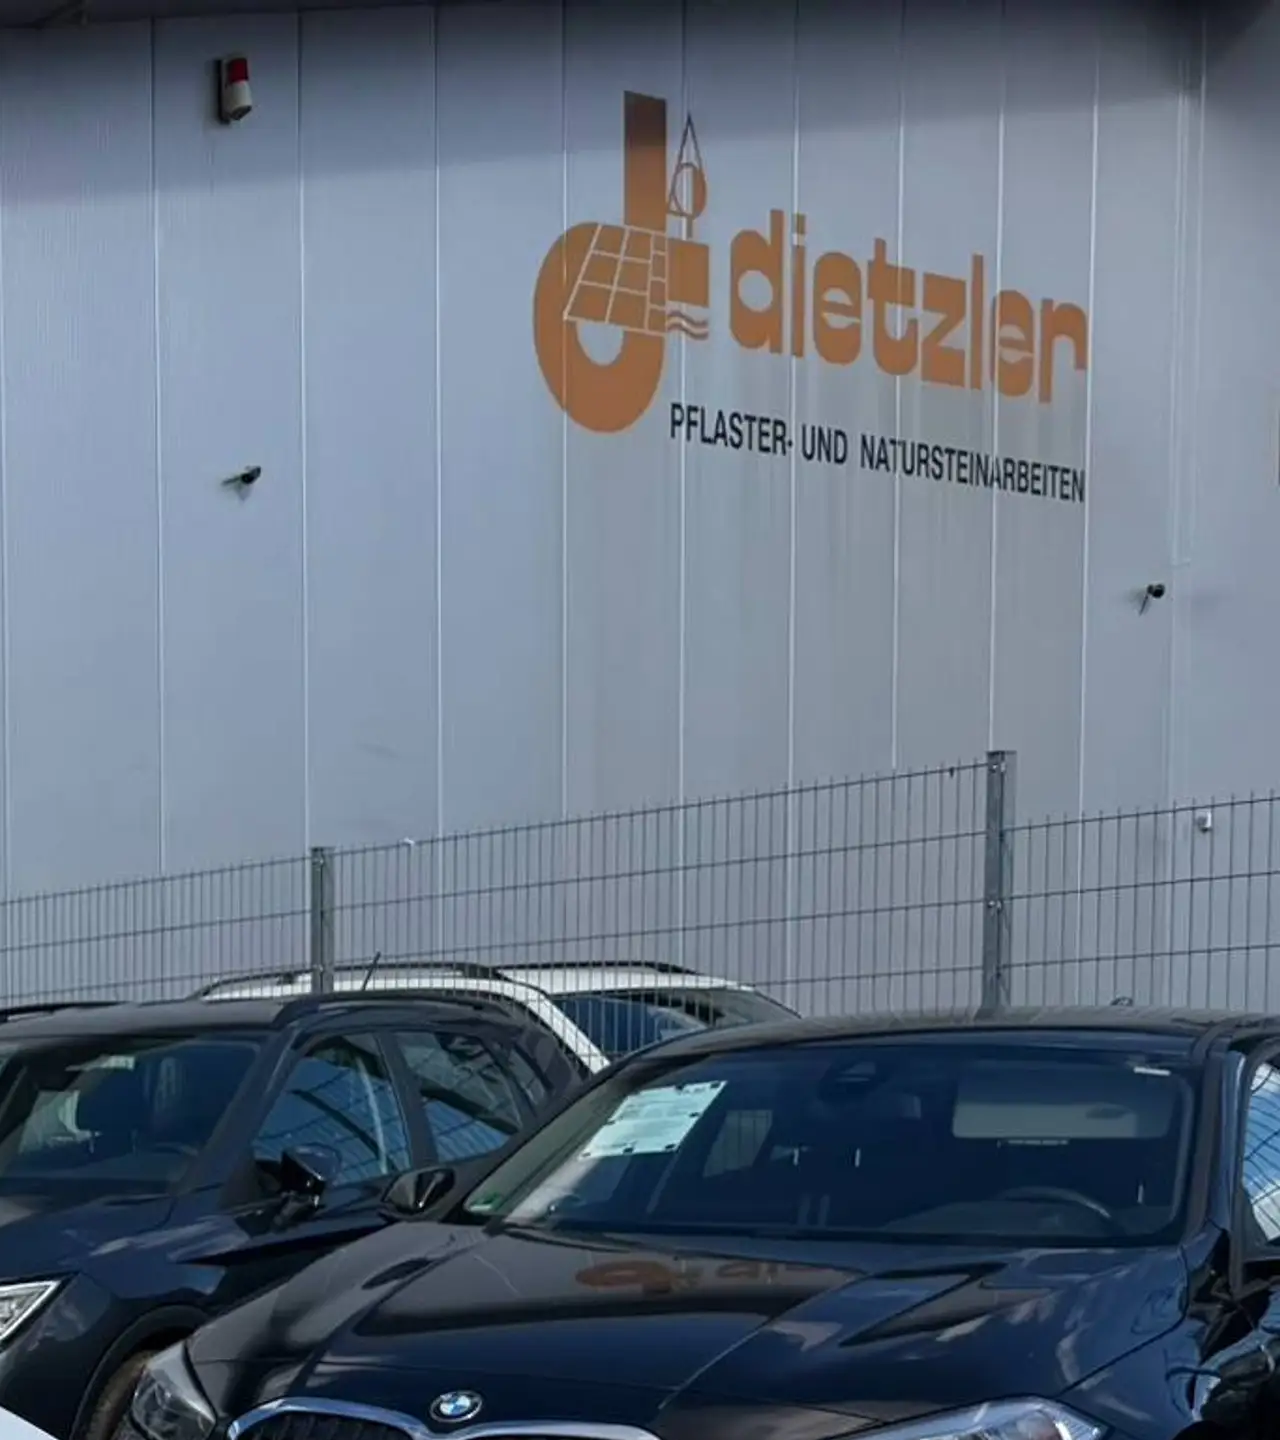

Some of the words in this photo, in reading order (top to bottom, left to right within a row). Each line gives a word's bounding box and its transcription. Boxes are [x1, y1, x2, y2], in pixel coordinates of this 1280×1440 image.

[729, 208, 1087, 404] dietzler
[670, 402, 793, 457] PFLASTER-
[801, 423, 849, 466] UND
[860, 433, 1086, 503] NATURSTEINARBEITEN
